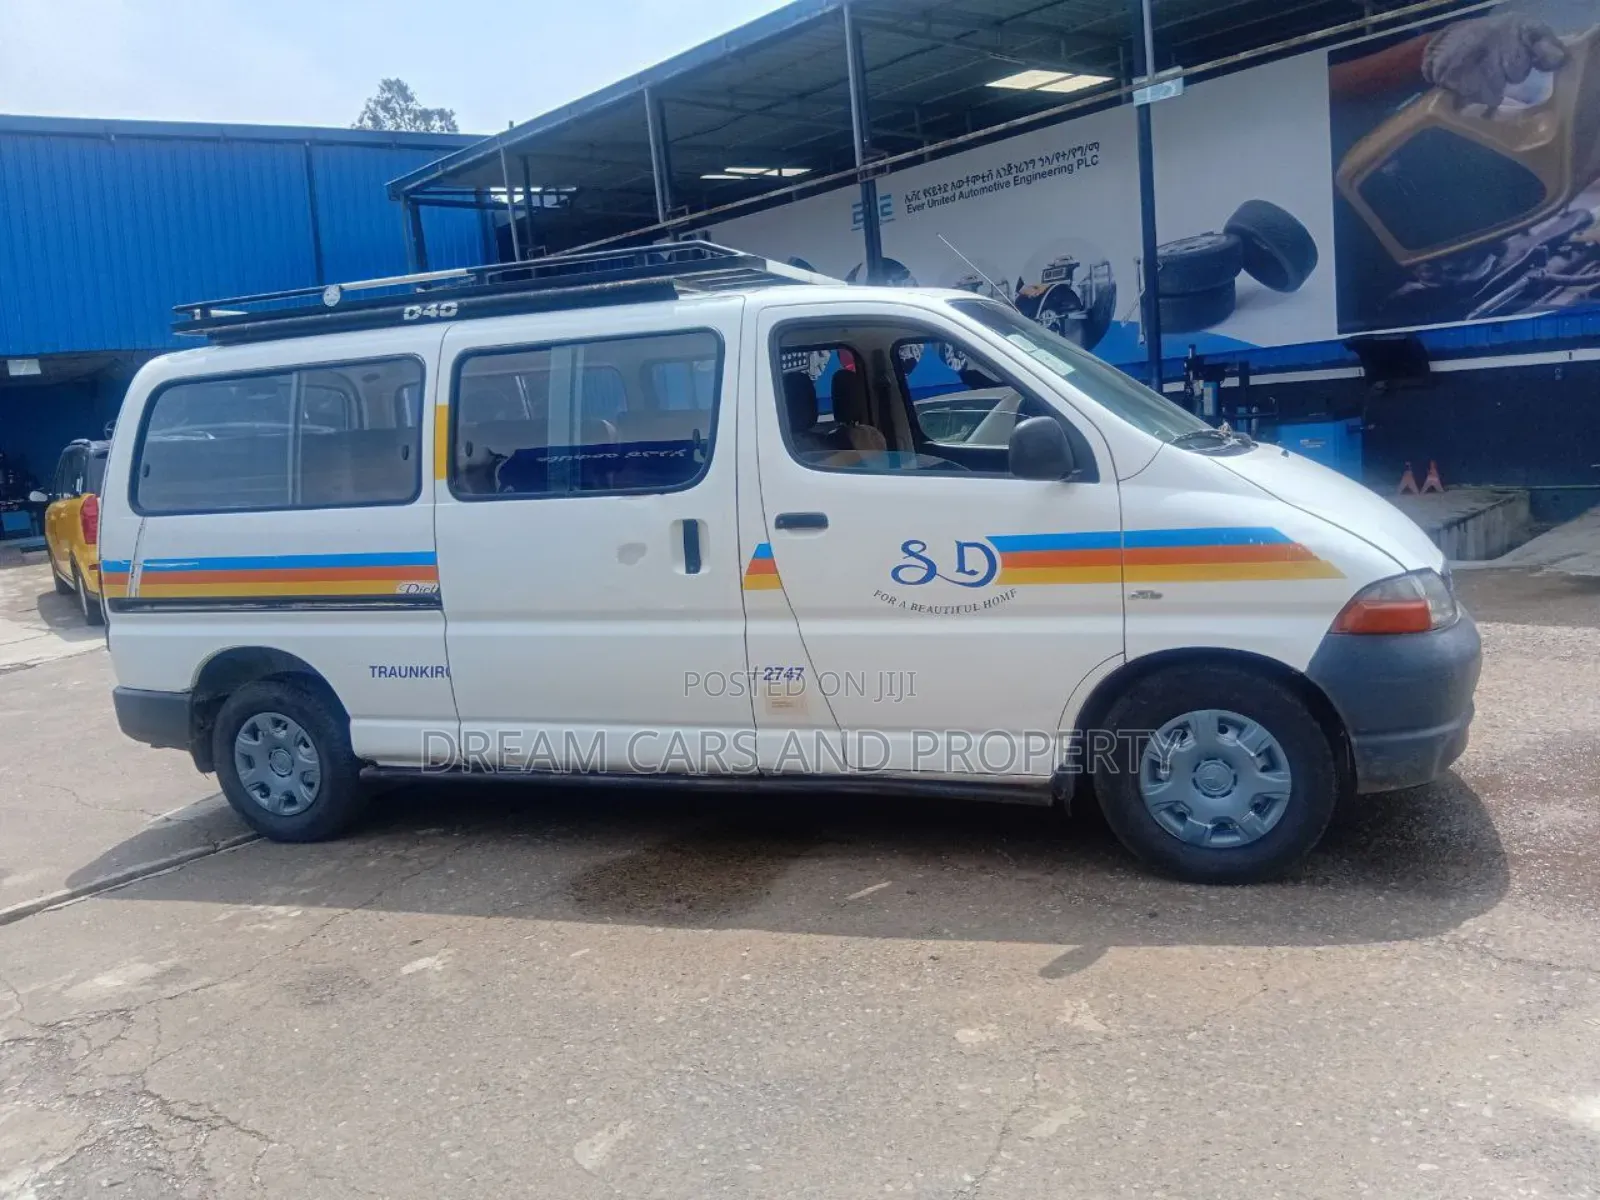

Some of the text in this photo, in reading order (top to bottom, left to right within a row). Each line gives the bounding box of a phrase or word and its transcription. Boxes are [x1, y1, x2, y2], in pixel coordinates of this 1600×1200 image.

[906, 154, 1099, 214] Ever United Automotive Engineering PLC
[873, 588, 1018, 615] FOR A BEAUTIFUL HOME
[763, 666, 805, 681] 2747
